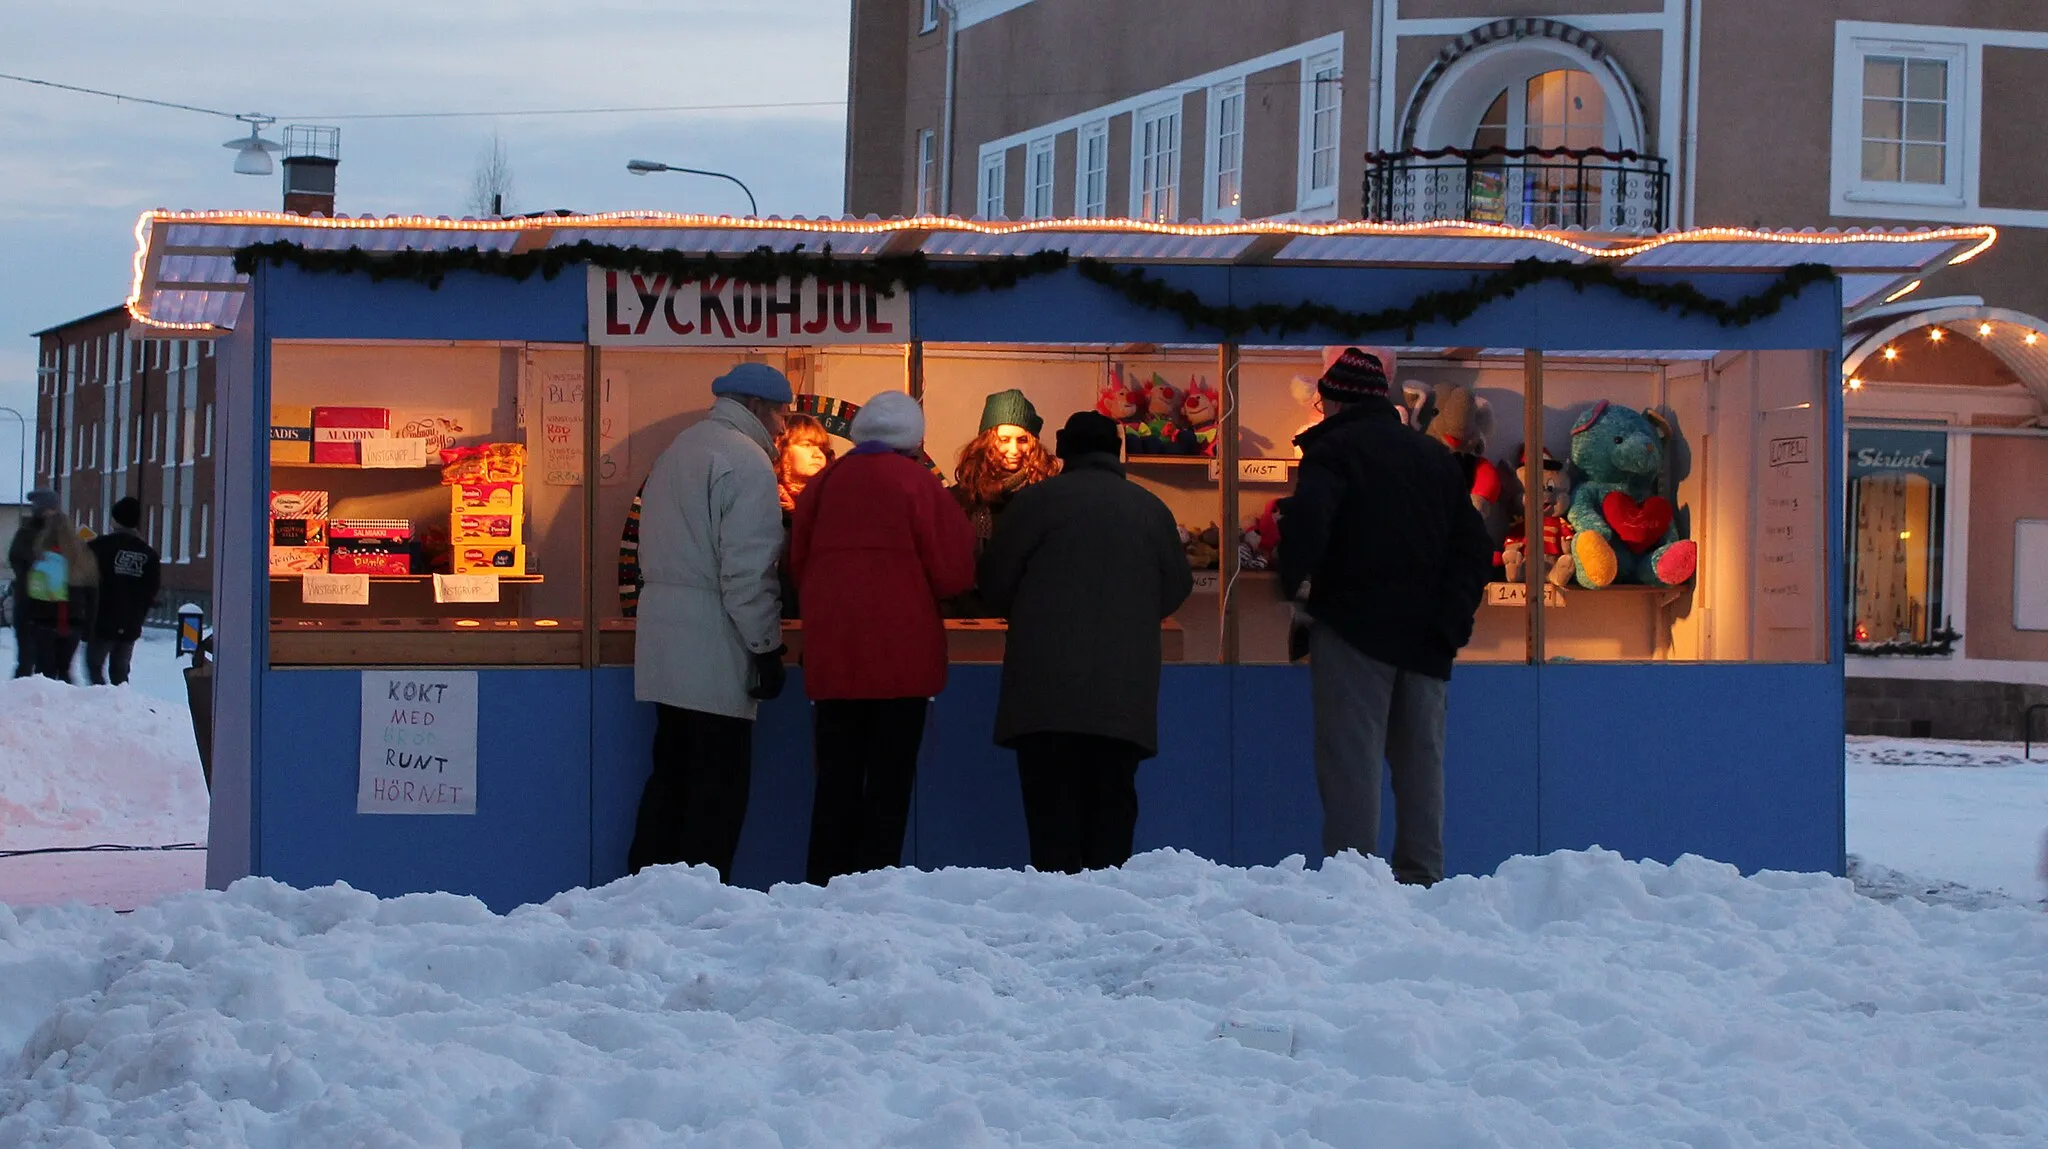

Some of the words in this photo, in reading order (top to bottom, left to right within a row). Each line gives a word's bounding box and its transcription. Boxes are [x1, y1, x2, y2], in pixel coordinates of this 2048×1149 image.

[606, 271, 893, 338] LYCKOHJUL
[825, 417, 832, 428] 6
[327, 430, 375, 439] ALADDIN
[353, 556, 386, 567] Dumle
[387, 680, 448, 704] KOKT
[390, 709, 435, 726] MED
[385, 748, 449, 773] RUNT
[373, 777, 463, 804] HÖRNET
